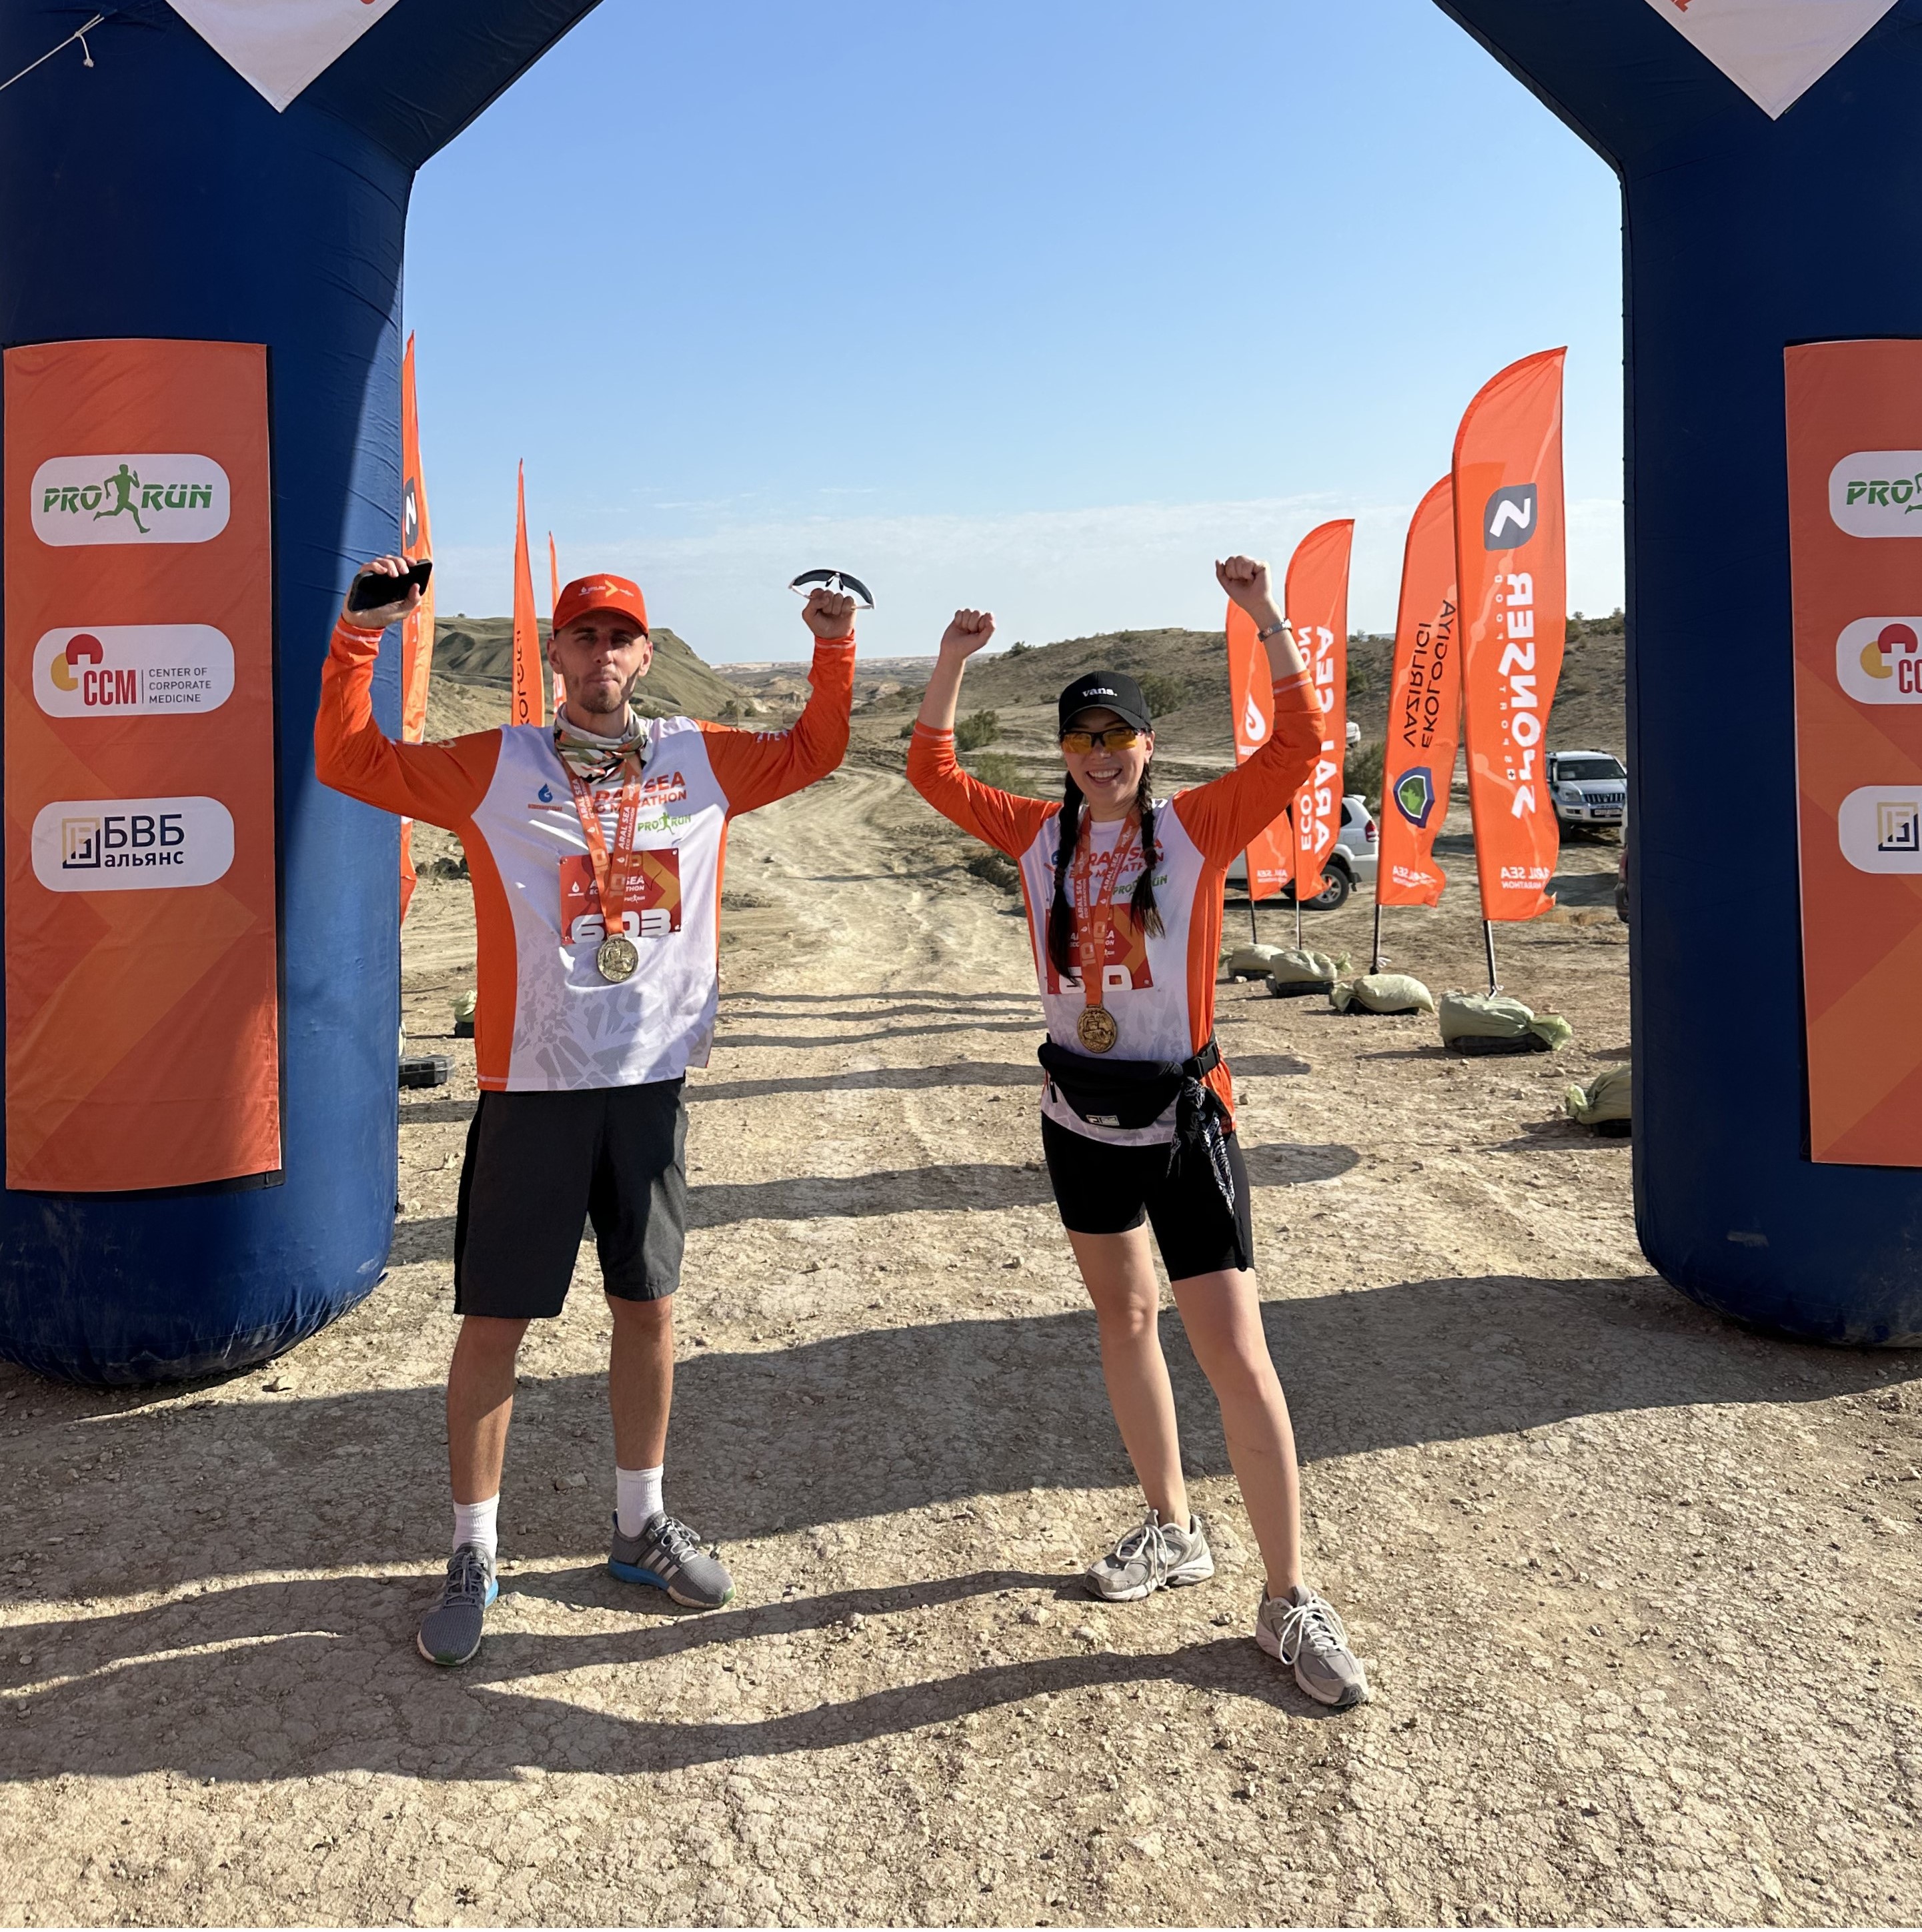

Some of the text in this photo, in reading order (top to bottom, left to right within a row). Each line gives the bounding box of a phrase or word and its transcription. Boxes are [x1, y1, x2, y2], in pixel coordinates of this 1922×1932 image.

[43, 484, 213, 514] PRO RUN
[1846, 479, 1914, 507] PRO
[149, 668, 207, 678] CENTER OF
[83, 670, 137, 706] CCM
[149, 680, 211, 690] CORPORATE
[1082, 688, 1118, 697] vans.
[149, 694, 201, 704] MEDICINE
[644, 771, 686, 794] SEA
[105, 814, 185, 848] БВБ
[617, 806, 630, 849] ARAL SEA
[638, 814, 692, 832] PRO RUN
[104, 851, 184, 867] альянс
[1152, 874, 1168, 887] UN
[1076, 896, 1084, 919] ARAL
